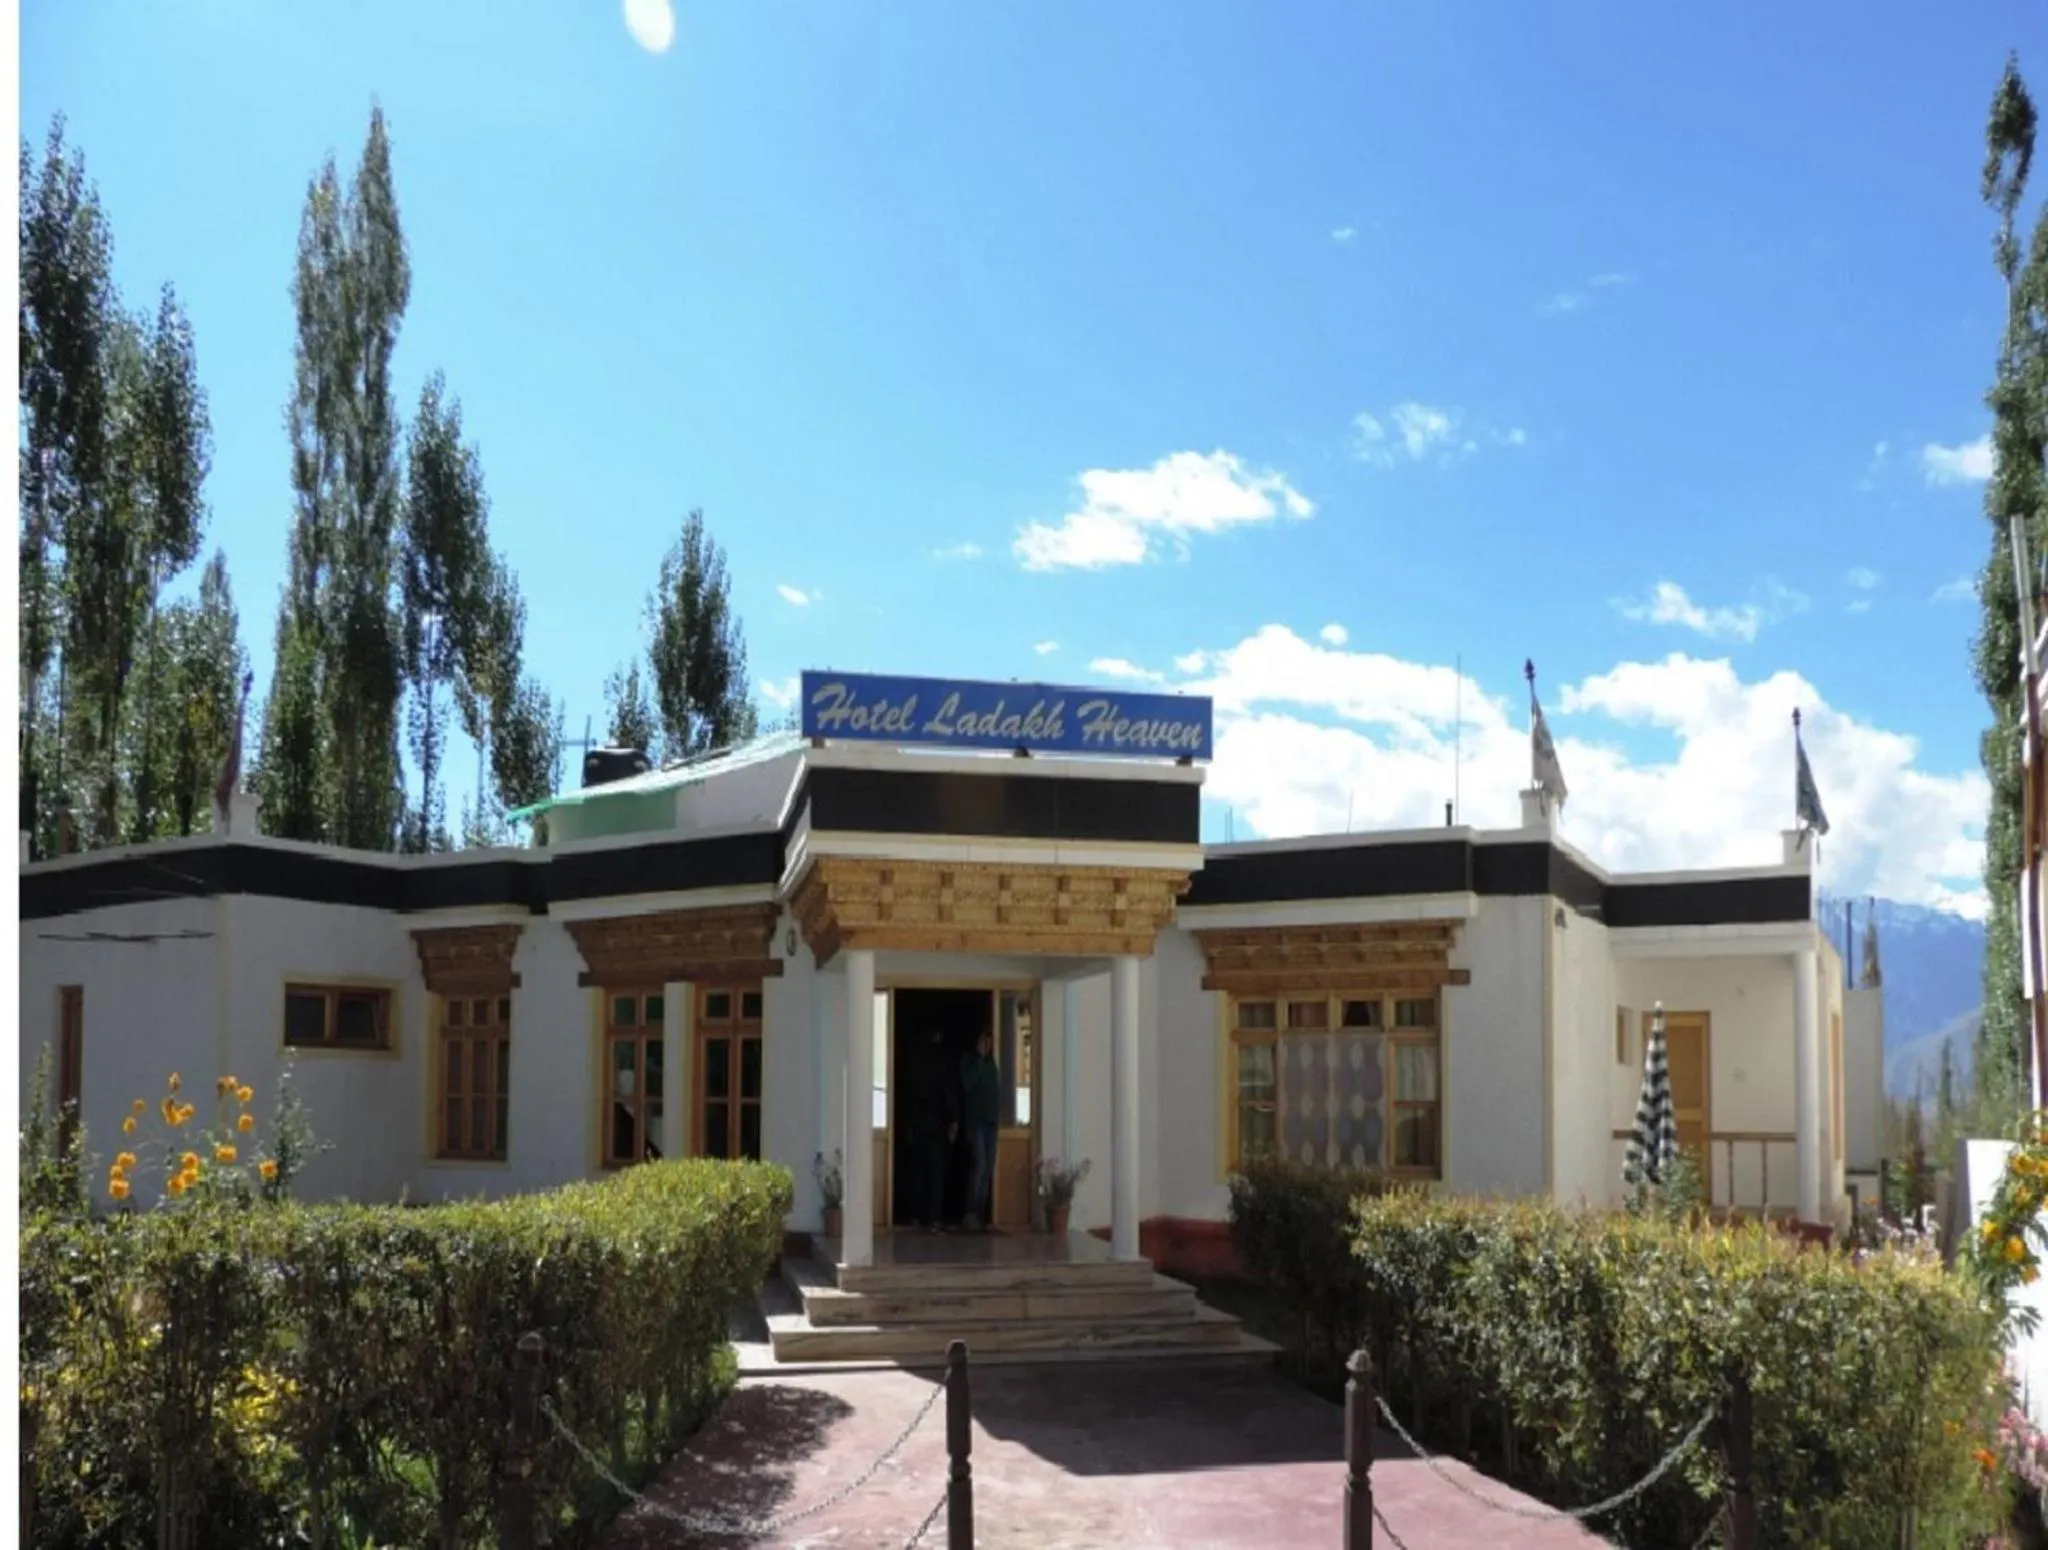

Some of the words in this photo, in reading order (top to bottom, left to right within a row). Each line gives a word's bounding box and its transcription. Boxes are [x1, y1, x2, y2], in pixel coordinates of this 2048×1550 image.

[811, 682, 917, 734] Hotel
[922, 691, 1065, 740] Ladakh
[1077, 699, 1203, 748] Heaven
